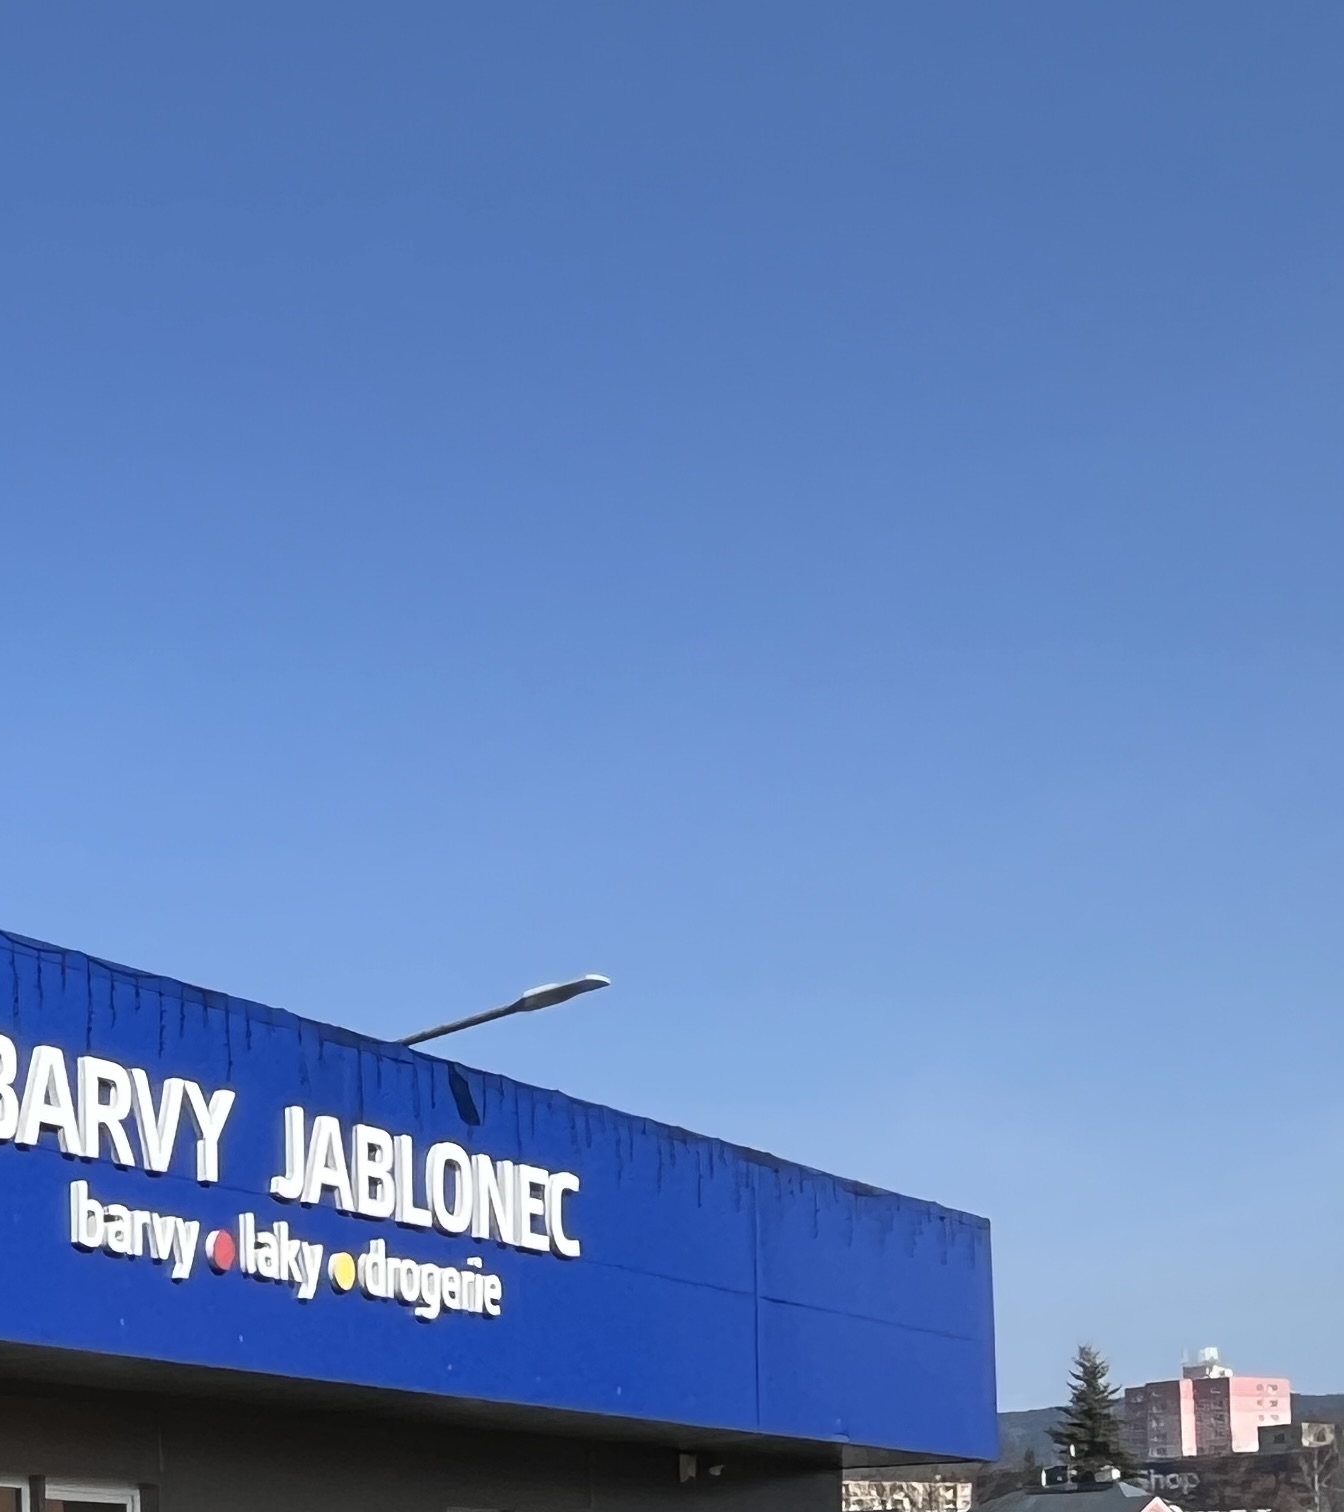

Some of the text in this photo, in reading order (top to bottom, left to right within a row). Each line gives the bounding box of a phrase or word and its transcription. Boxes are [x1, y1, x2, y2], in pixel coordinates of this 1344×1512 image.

[70, 1180, 502, 1320] barvy laky drogerie
[269, 1105, 581, 1258] JABLONEC
